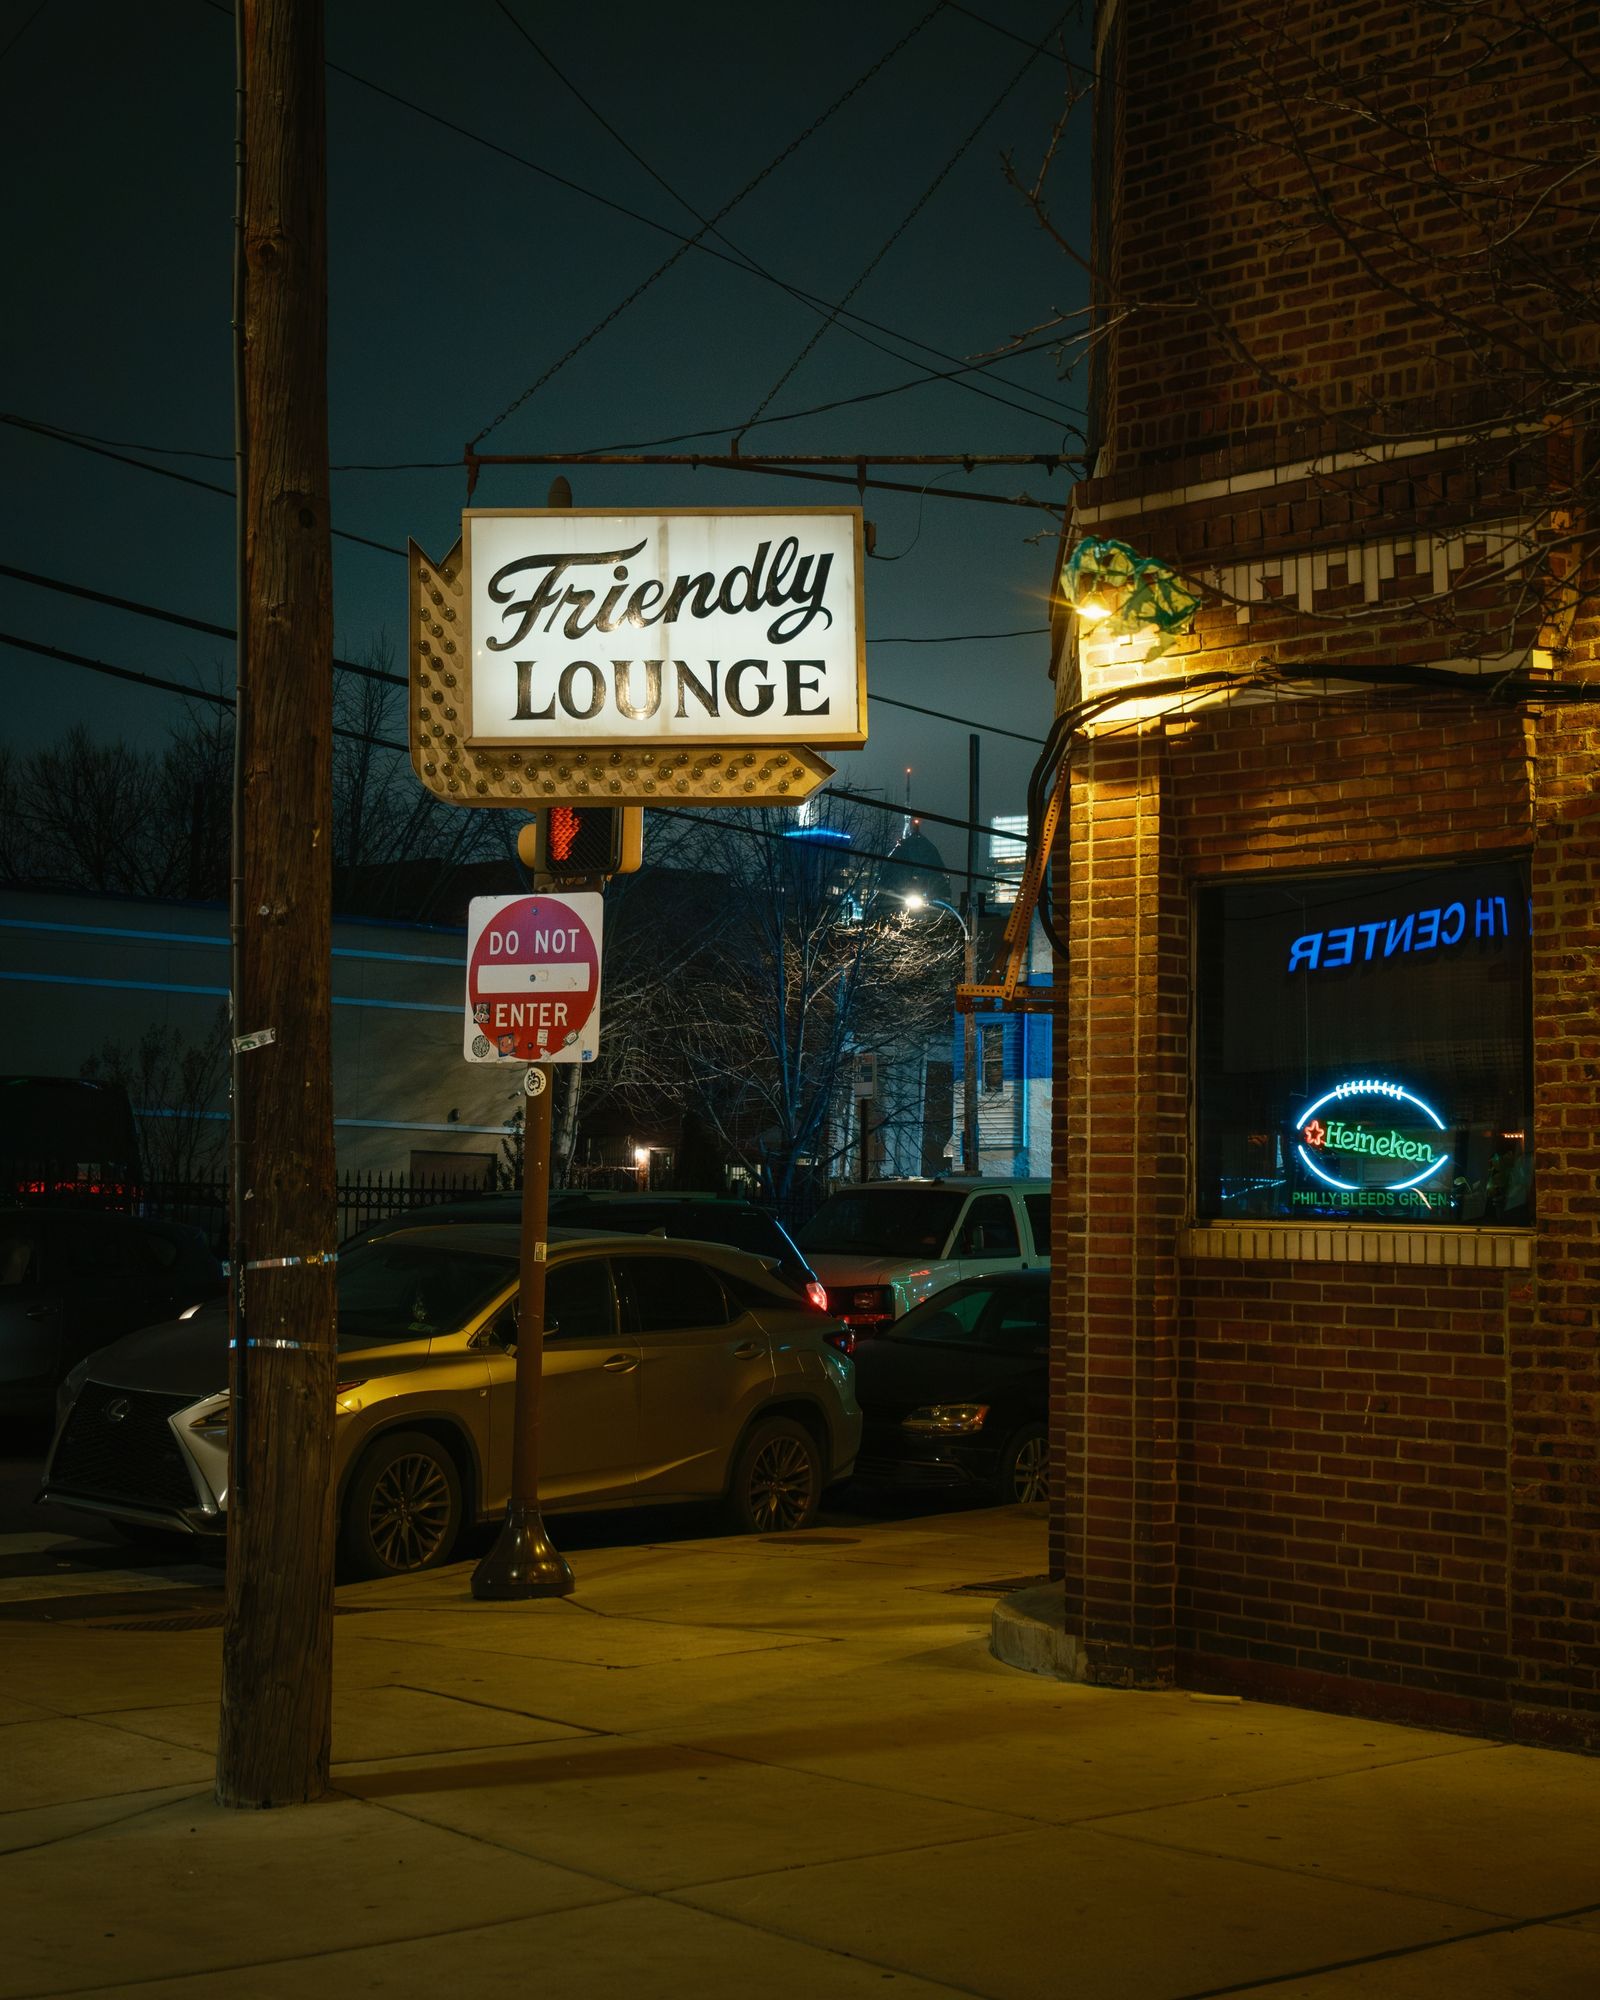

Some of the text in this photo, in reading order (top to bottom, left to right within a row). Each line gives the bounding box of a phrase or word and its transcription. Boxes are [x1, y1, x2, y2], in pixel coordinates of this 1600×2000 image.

[486, 536, 835, 651] Friendly
[511, 659, 830, 720] LOUNGE
[489, 929, 580, 955] DO NOT
[495, 1003, 568, 1027] ENTER
[1324, 1121, 1435, 1163] Heineken
[1292, 1192, 1446, 1205] PHILLY BLEEDS GREEN
